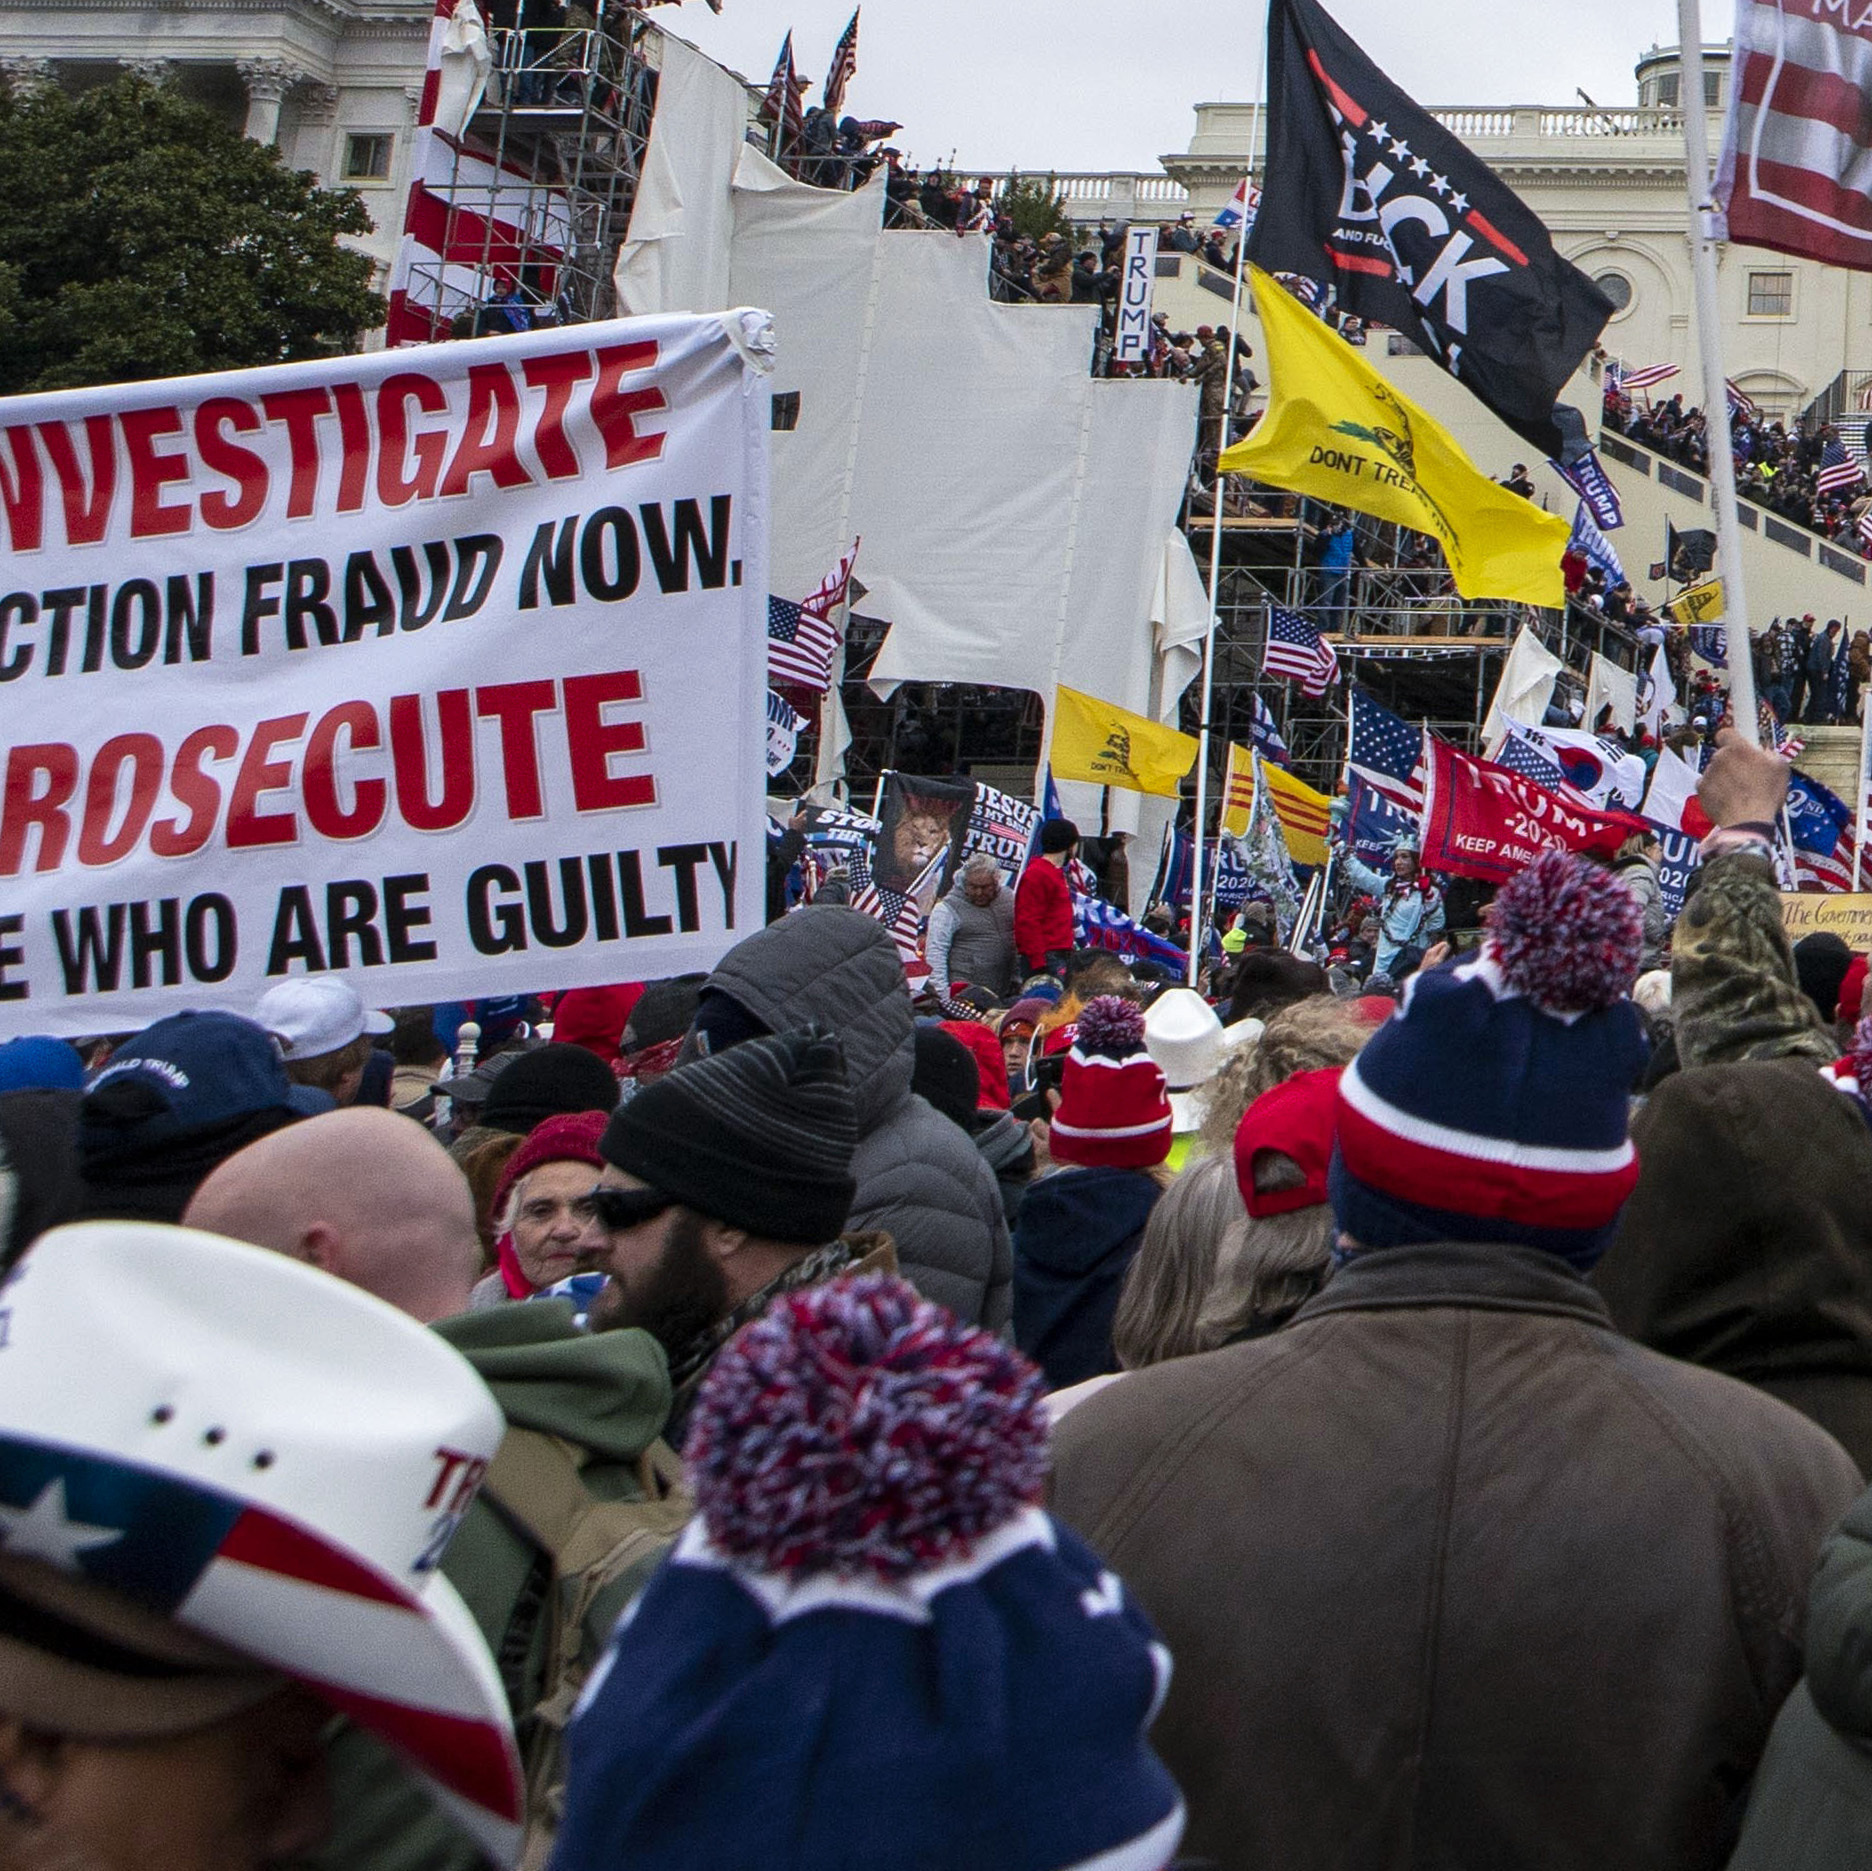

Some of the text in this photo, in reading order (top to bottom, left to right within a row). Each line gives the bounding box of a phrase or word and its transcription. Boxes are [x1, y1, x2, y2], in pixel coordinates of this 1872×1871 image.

[1333, 228, 1391, 252] AND FUC
[1310, 445, 1417, 494] DONT TRE
[1576, 452, 1617, 526] TRUMP
[241, 534, 504, 657] FRAUD
[518, 494, 742, 610] NOW.
[0, 669, 658, 876] ROSECUTE
[985, 808, 1005, 823] MY
[827, 828, 865, 846] THE
[1455, 833, 1495, 854] KEEP
[1219, 875, 1256, 890] 2020
[52, 891, 237, 996] WHO
[267, 872, 437, 979] ARE
[466, 841, 738, 956] GUILTY
[1784, 900, 1812, 926] The
